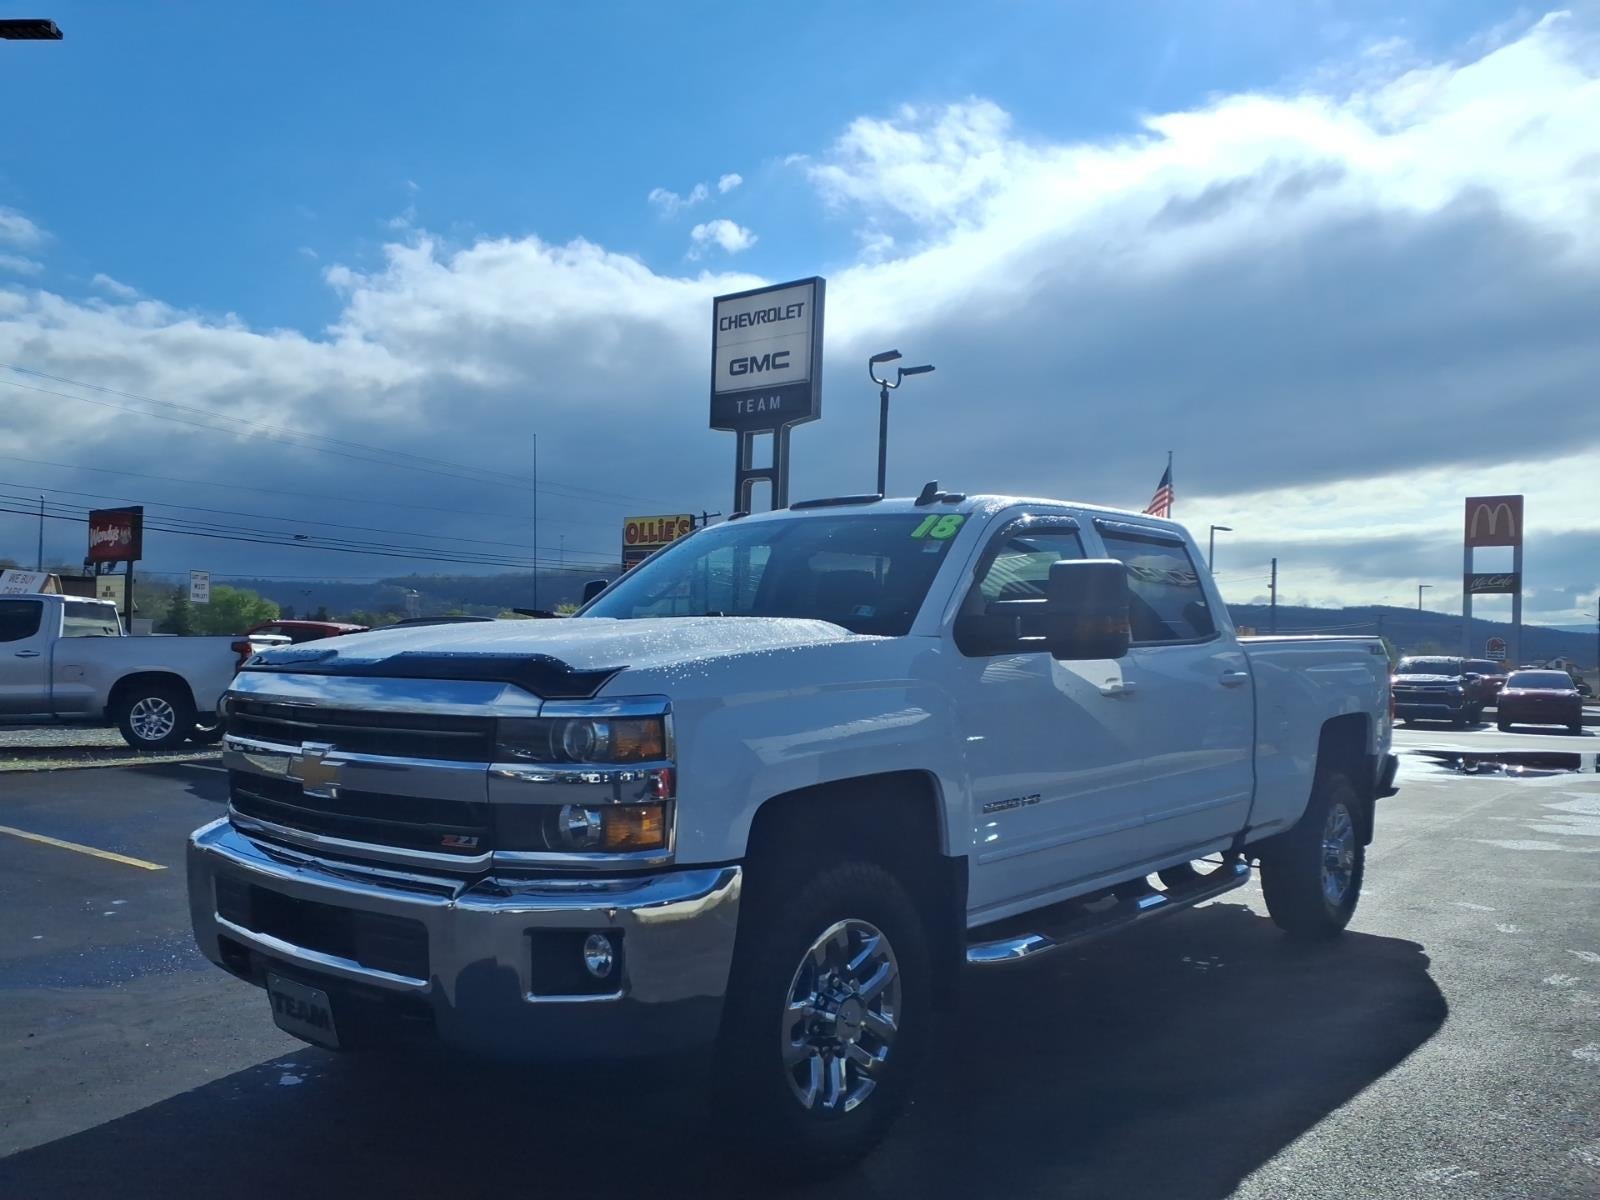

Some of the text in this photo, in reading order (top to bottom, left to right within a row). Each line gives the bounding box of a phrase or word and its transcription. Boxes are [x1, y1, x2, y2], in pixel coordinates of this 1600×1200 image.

[720, 302, 805, 332] CHEVROLET
[729, 350, 790, 376] GMC
[736, 396, 780, 413] TEAM
[90, 524, 120, 548] Wendy's
[910, 513, 965, 539] 18
[272, 991, 330, 1030] TEAM
